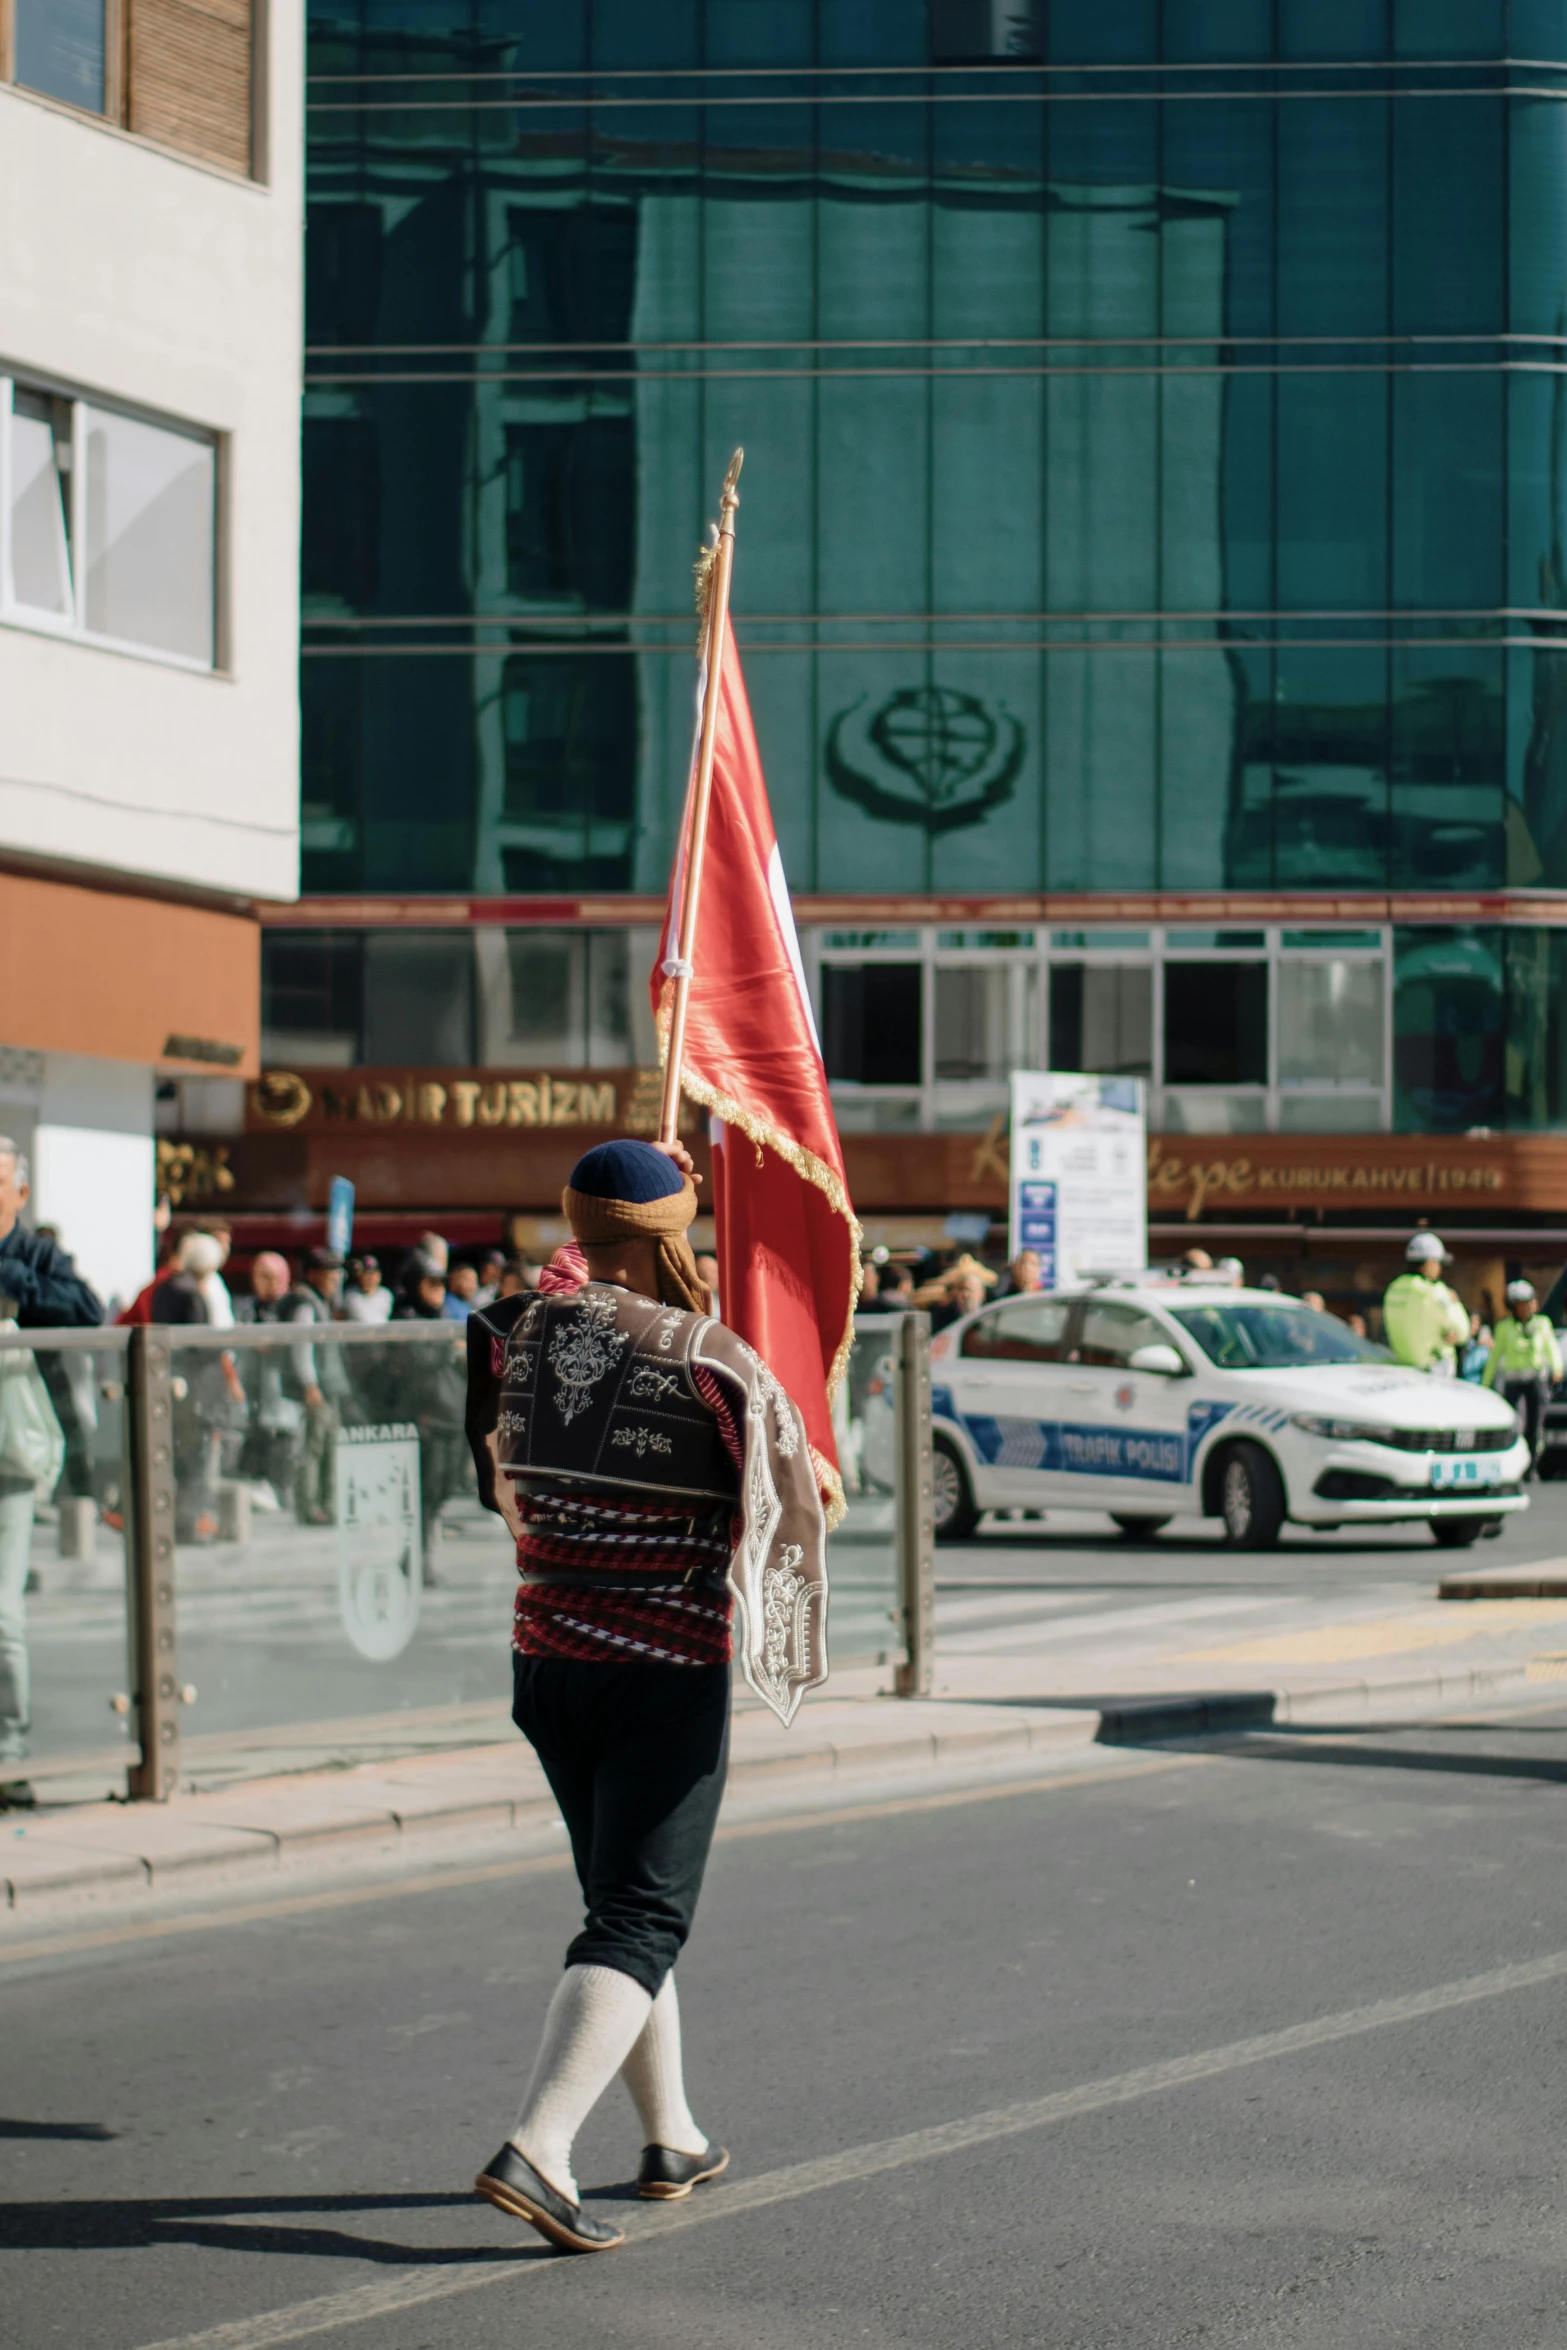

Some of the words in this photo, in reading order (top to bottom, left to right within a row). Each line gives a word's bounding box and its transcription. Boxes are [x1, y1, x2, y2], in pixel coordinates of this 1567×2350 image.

[452, 1071, 616, 1128] TURİZM
[337, 1423, 419, 1443] ANKARA
[1064, 1433, 1122, 1467] TRAFİK
[1125, 1437, 1179, 1473] POLİSİ
